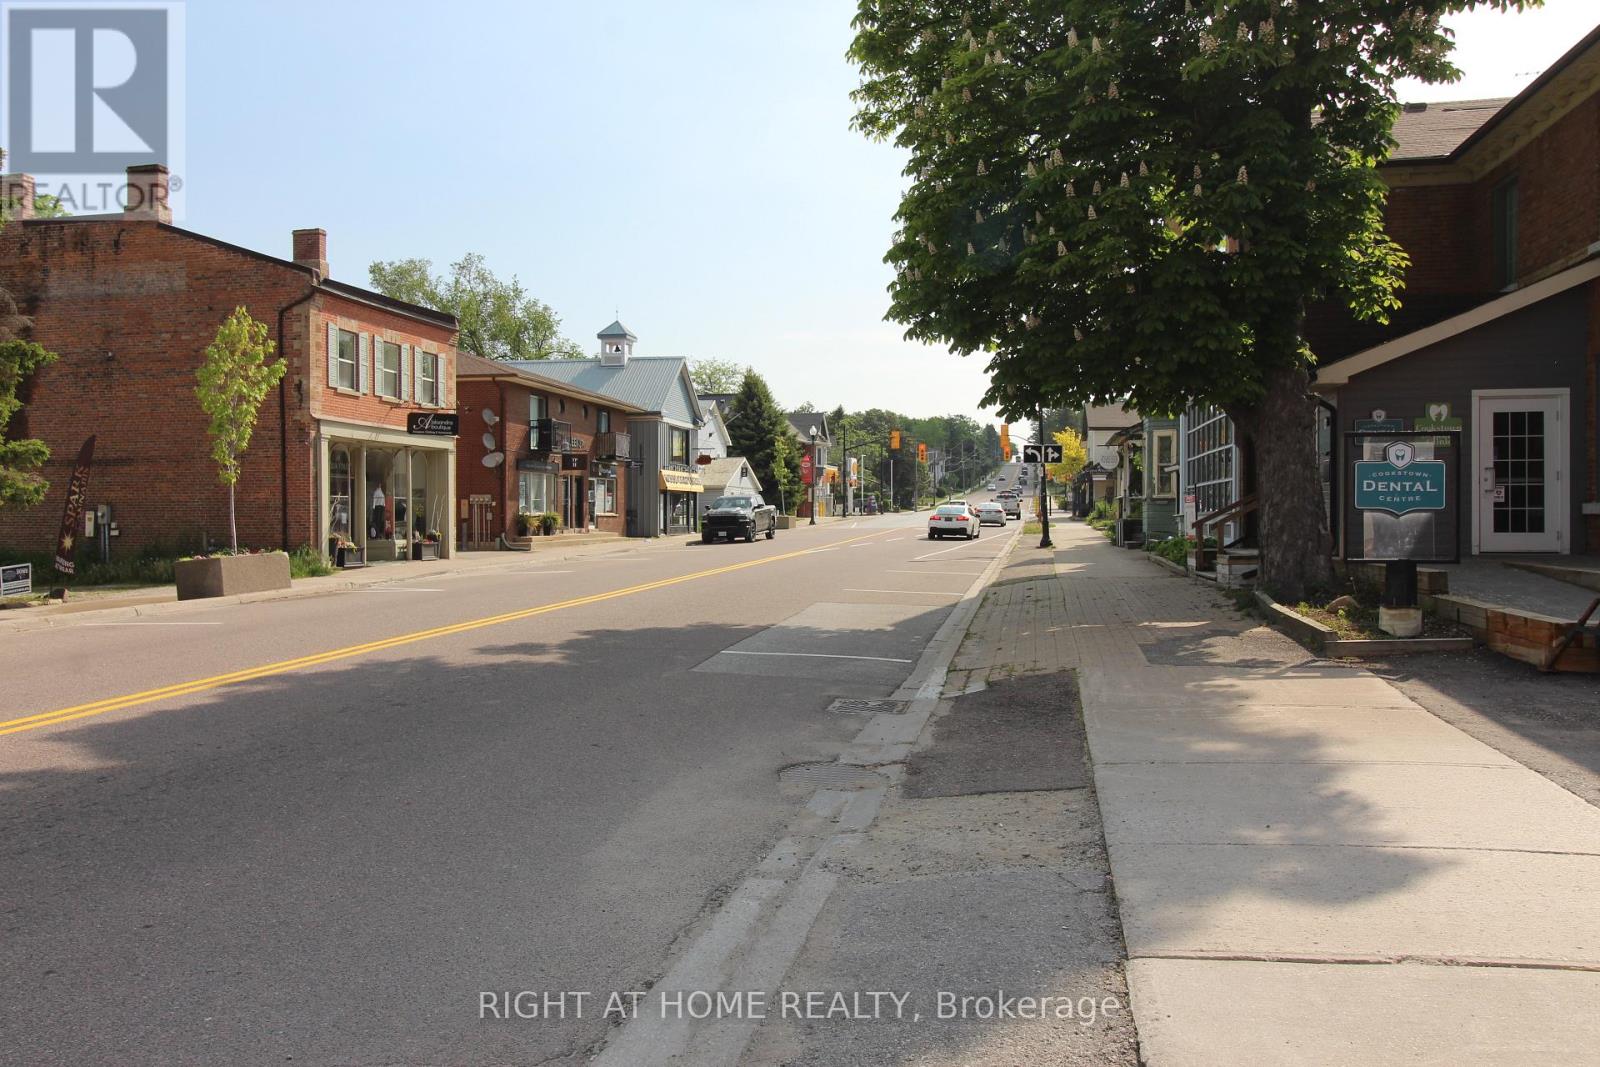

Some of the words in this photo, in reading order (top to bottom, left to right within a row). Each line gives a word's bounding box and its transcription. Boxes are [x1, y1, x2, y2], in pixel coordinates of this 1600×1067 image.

[1371, 470, 1429, 478] COOKSTOWN
[1362, 480, 1438, 492] DENTAL
[64, 465, 84, 528] SPARK
